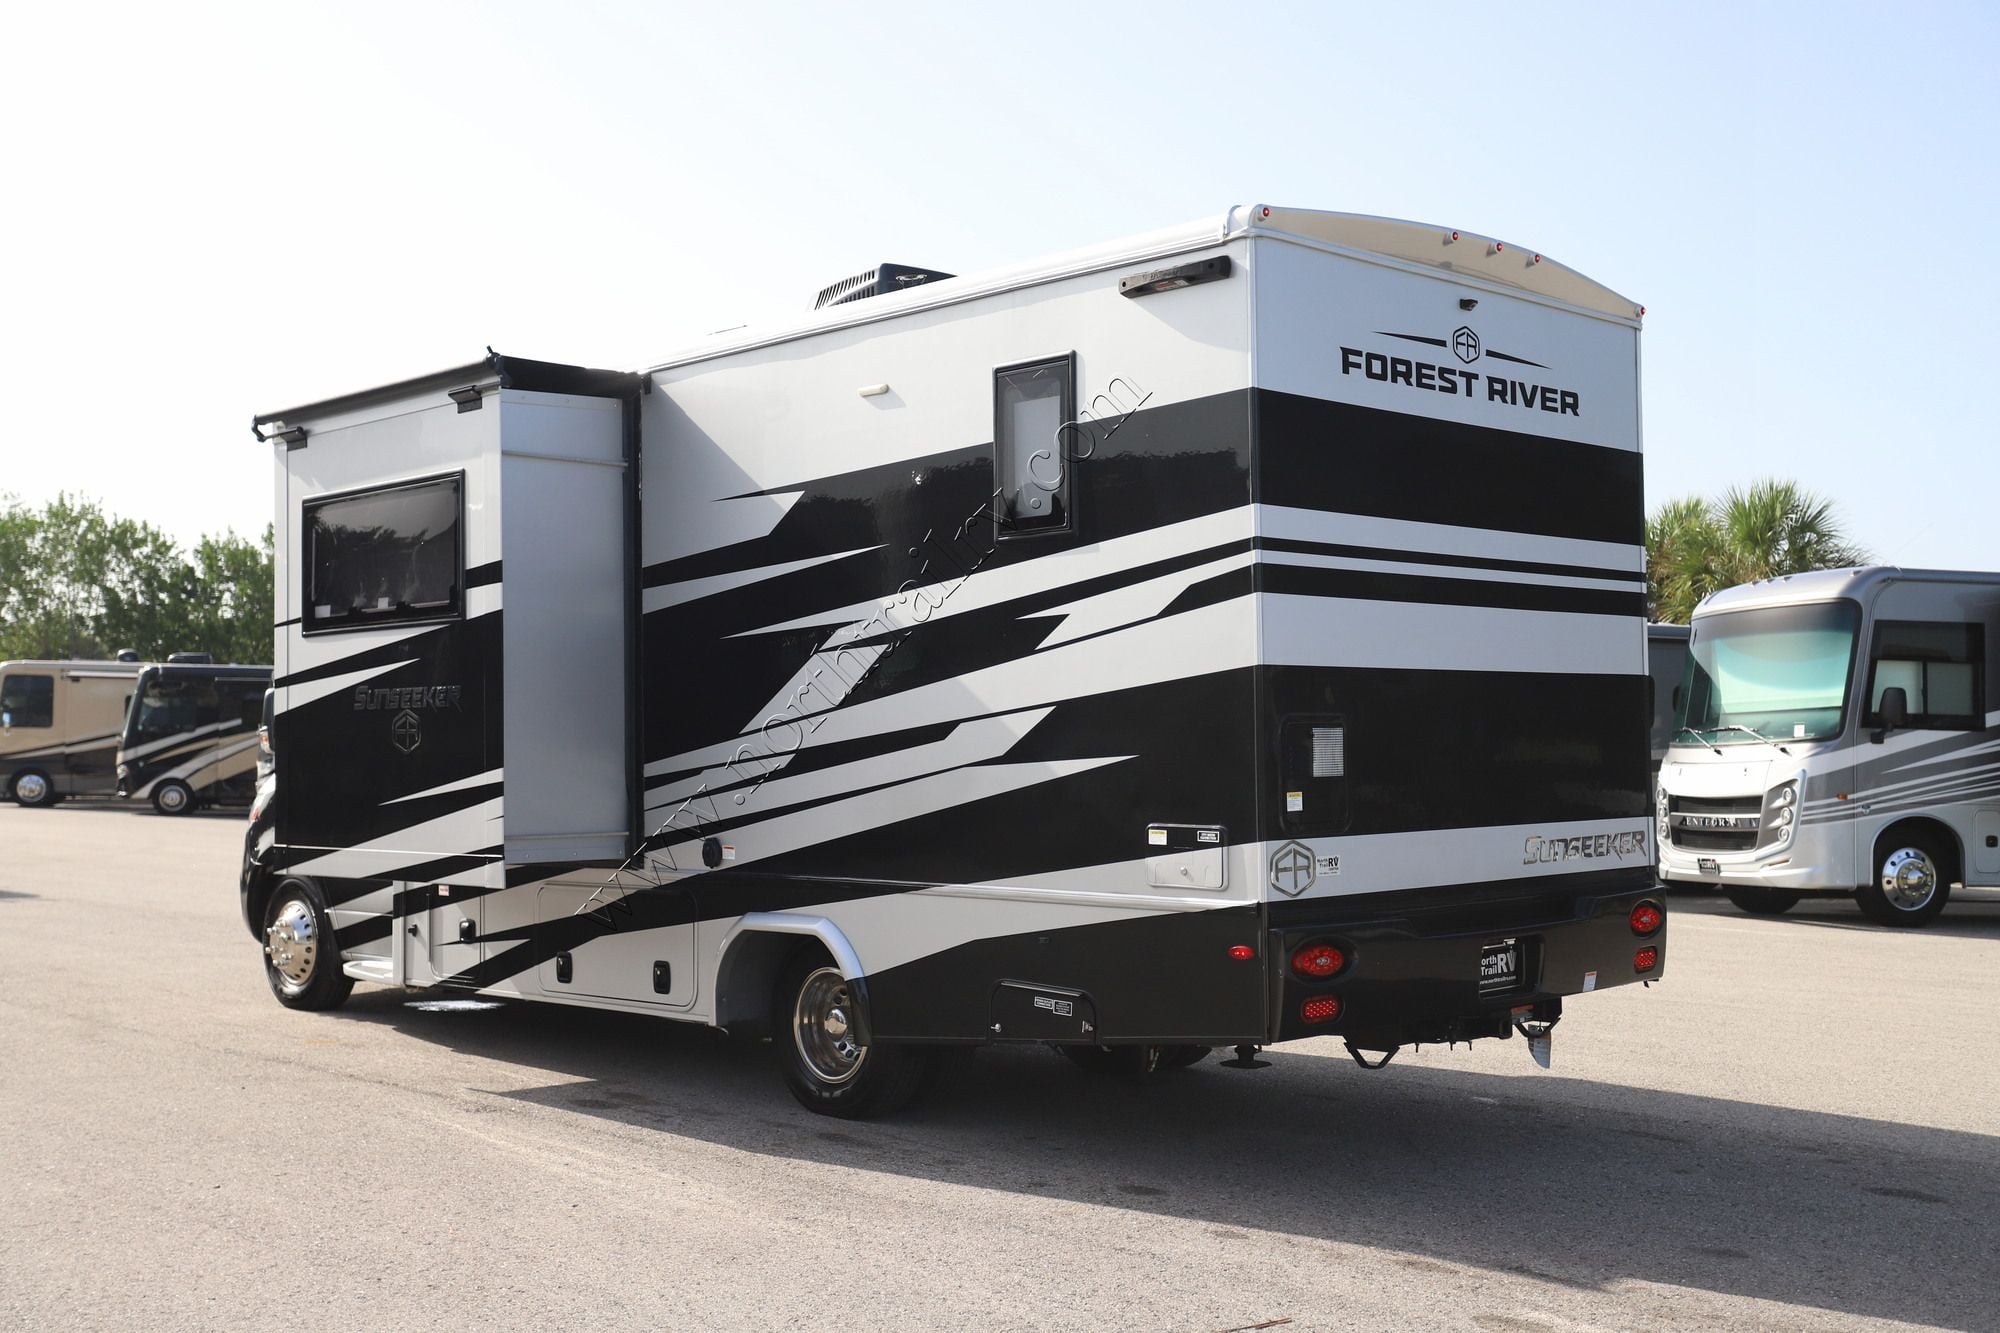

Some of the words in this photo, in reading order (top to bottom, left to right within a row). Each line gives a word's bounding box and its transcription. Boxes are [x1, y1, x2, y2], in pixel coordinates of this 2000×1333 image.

[1340, 346, 1479, 397] FOREST
[1486, 375, 1580, 417] RIVER
[1481, 955, 1497, 966] orth
[1497, 951, 1517, 973] RV
[1481, 965, 1497, 975] Trail
